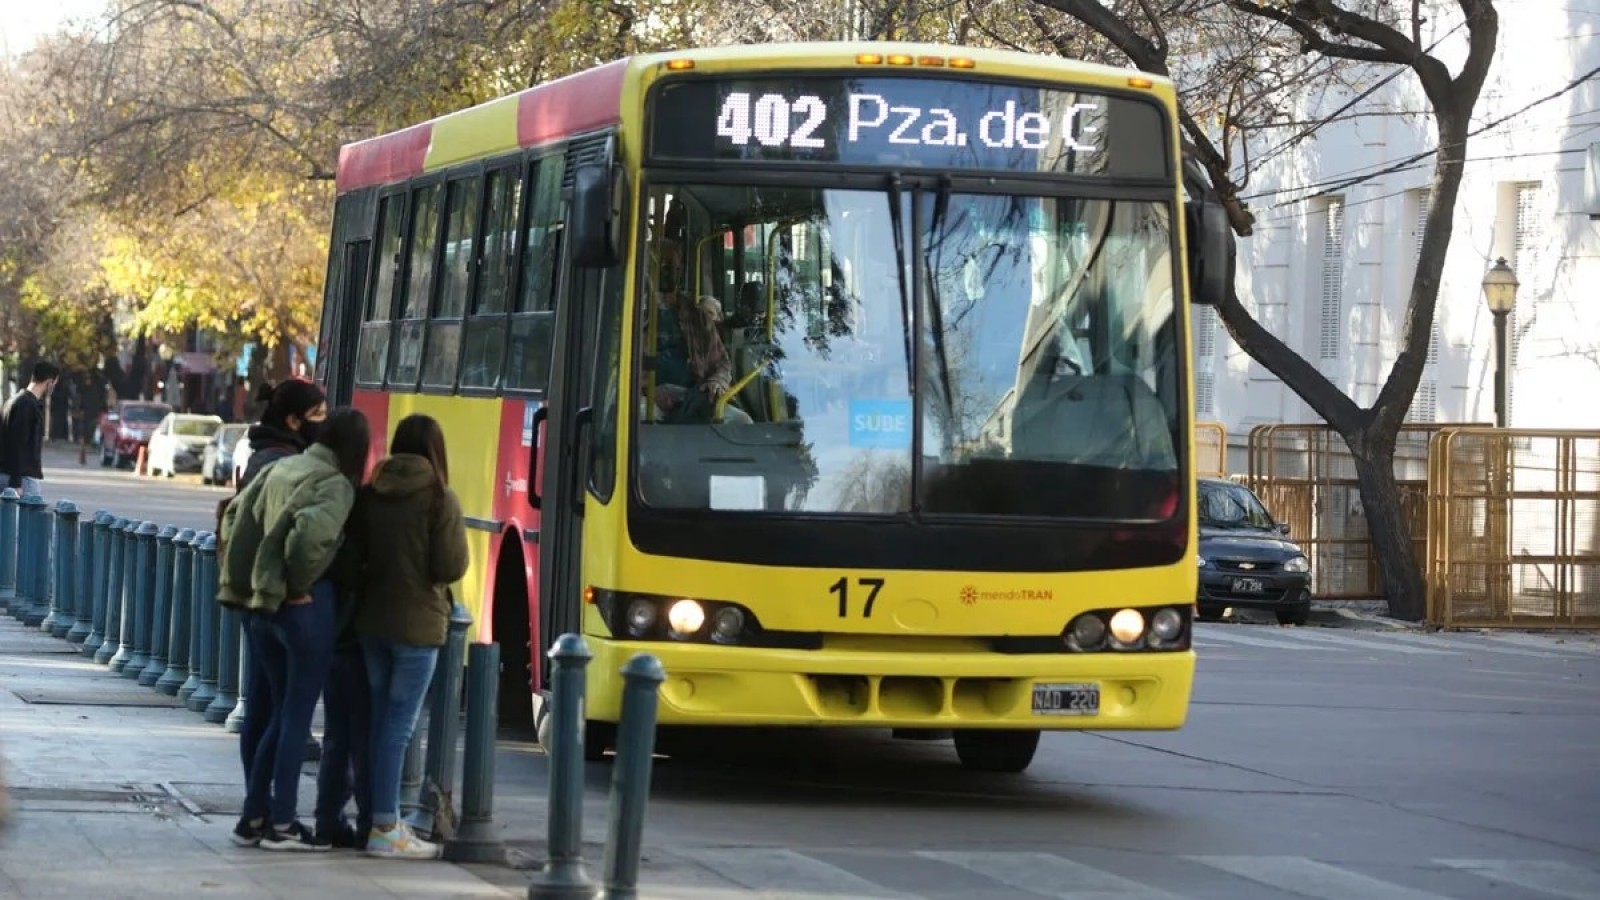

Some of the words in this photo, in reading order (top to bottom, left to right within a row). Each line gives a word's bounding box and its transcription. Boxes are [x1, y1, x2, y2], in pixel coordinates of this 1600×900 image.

[717, 92, 826, 148] 402
[848, 93, 966, 146] Pza.
[978, 100, 1050, 149] de
[854, 413, 905, 432] SUBE
[828, 577, 885, 618] 17
[1034, 690, 1060, 709] NAD
[1071, 690, 1097, 709] 220
